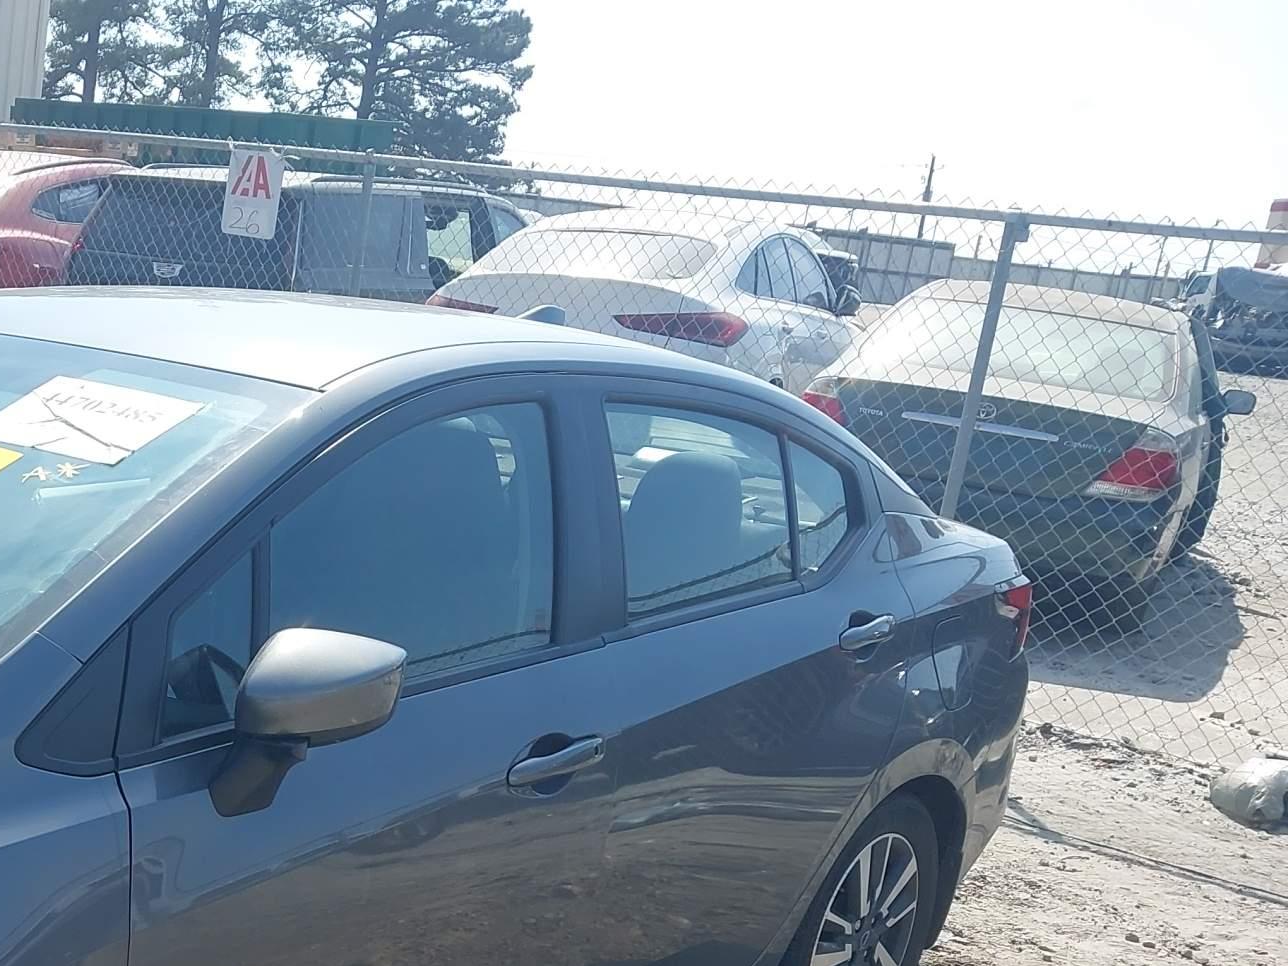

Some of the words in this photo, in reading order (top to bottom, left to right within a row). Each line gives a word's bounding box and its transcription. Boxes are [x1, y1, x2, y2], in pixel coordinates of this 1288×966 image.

[231, 155, 272, 200] IAA
[228, 206, 260, 235] 26
[42, 392, 165, 423] 44702485
[859, 407, 883, 417] TOYOTA
